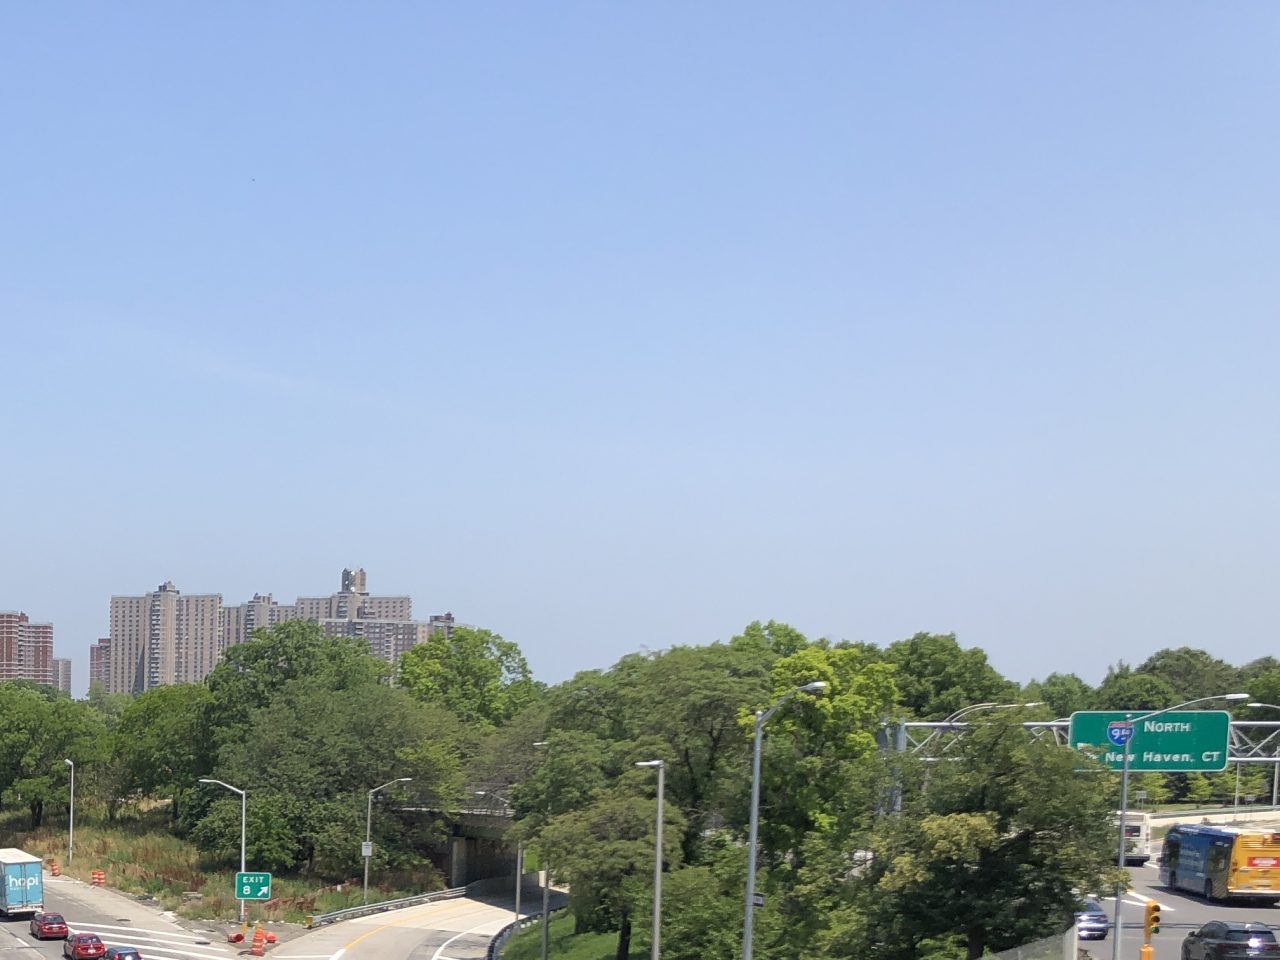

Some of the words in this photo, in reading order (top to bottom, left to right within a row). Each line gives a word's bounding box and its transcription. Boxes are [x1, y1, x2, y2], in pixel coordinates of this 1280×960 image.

[1144, 721, 1191, 732] NORTH
[1202, 752, 1221, 762] CT
[9, 874, 39, 890] hopi
[243, 886, 251, 895] 8
